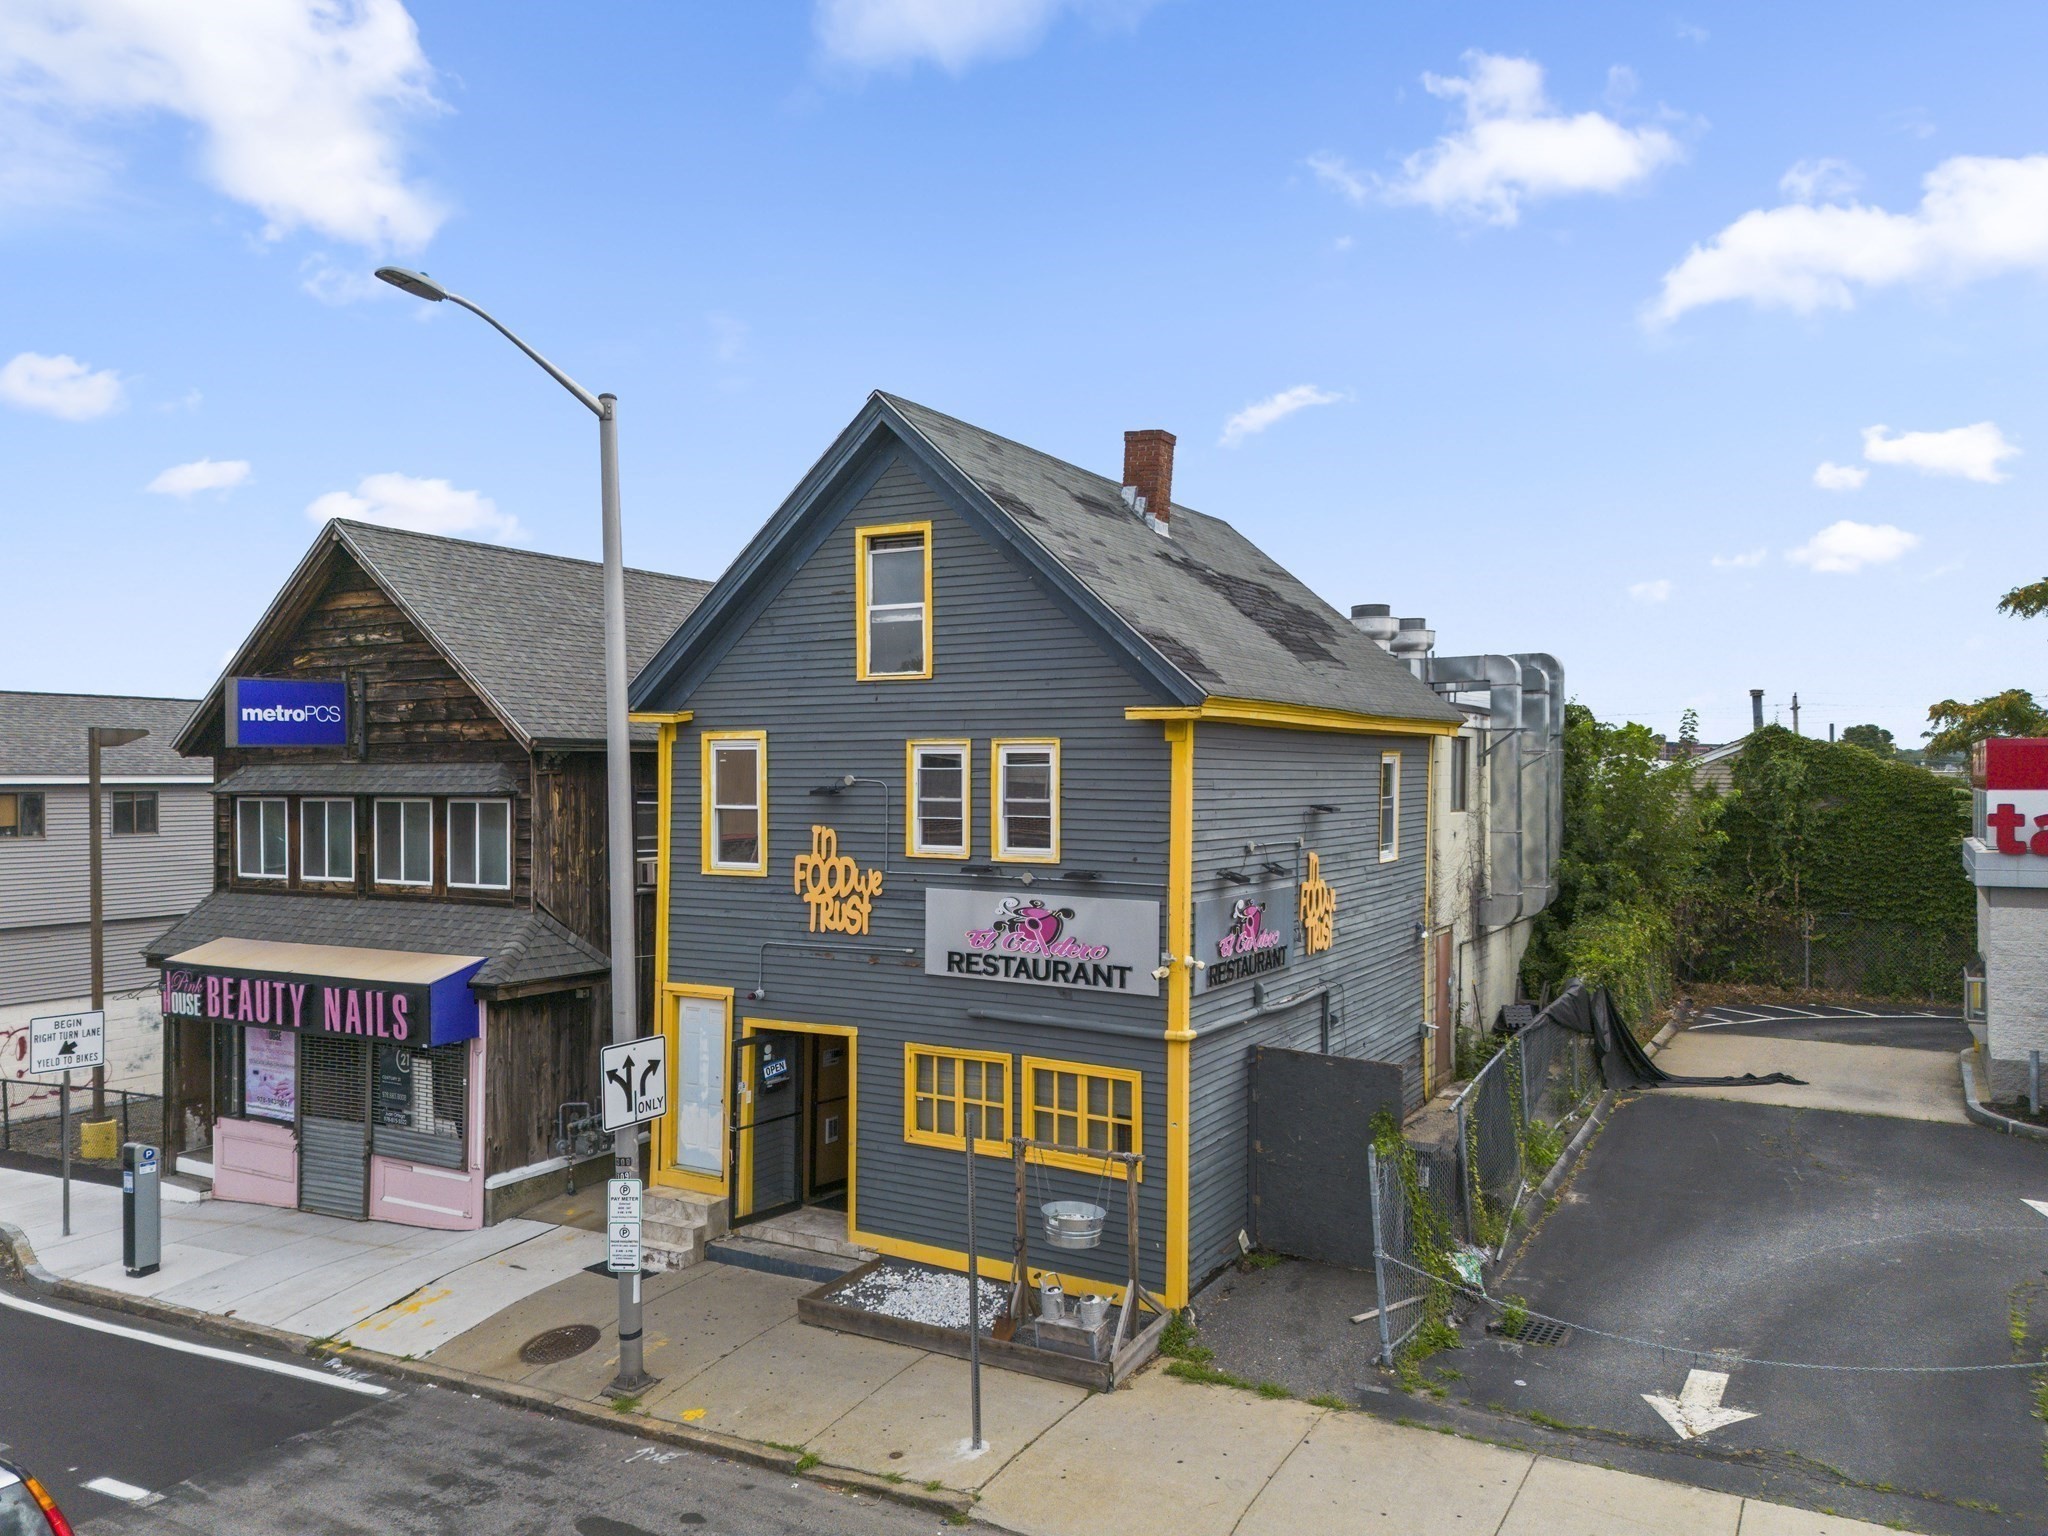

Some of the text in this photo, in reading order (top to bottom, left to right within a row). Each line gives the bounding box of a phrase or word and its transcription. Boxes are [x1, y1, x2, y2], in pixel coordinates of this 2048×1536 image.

[242, 705, 341, 722] metroPCS
[811, 825, 837, 860] In
[794, 854, 857, 898] FOOD
[1300, 879, 1327, 921] FOOD
[964, 928, 999, 952] El
[946, 951, 1133, 989] RESTAURANT
[1208, 946, 1288, 988] RESTAURANT
[171, 970, 203, 993] Pink
[162, 977, 202, 1016] HOUSE
[206, 975, 409, 1041] BEAUTY NAILS
[34, 1027, 101, 1043] RIGHT TURN LANE
[54, 1018, 82, 1029] BEGIN
[37, 1053, 99, 1068] YIELD TO BIKES
[765, 1061, 785, 1076] OPEN
[638, 1096, 664, 1113] ONLY
